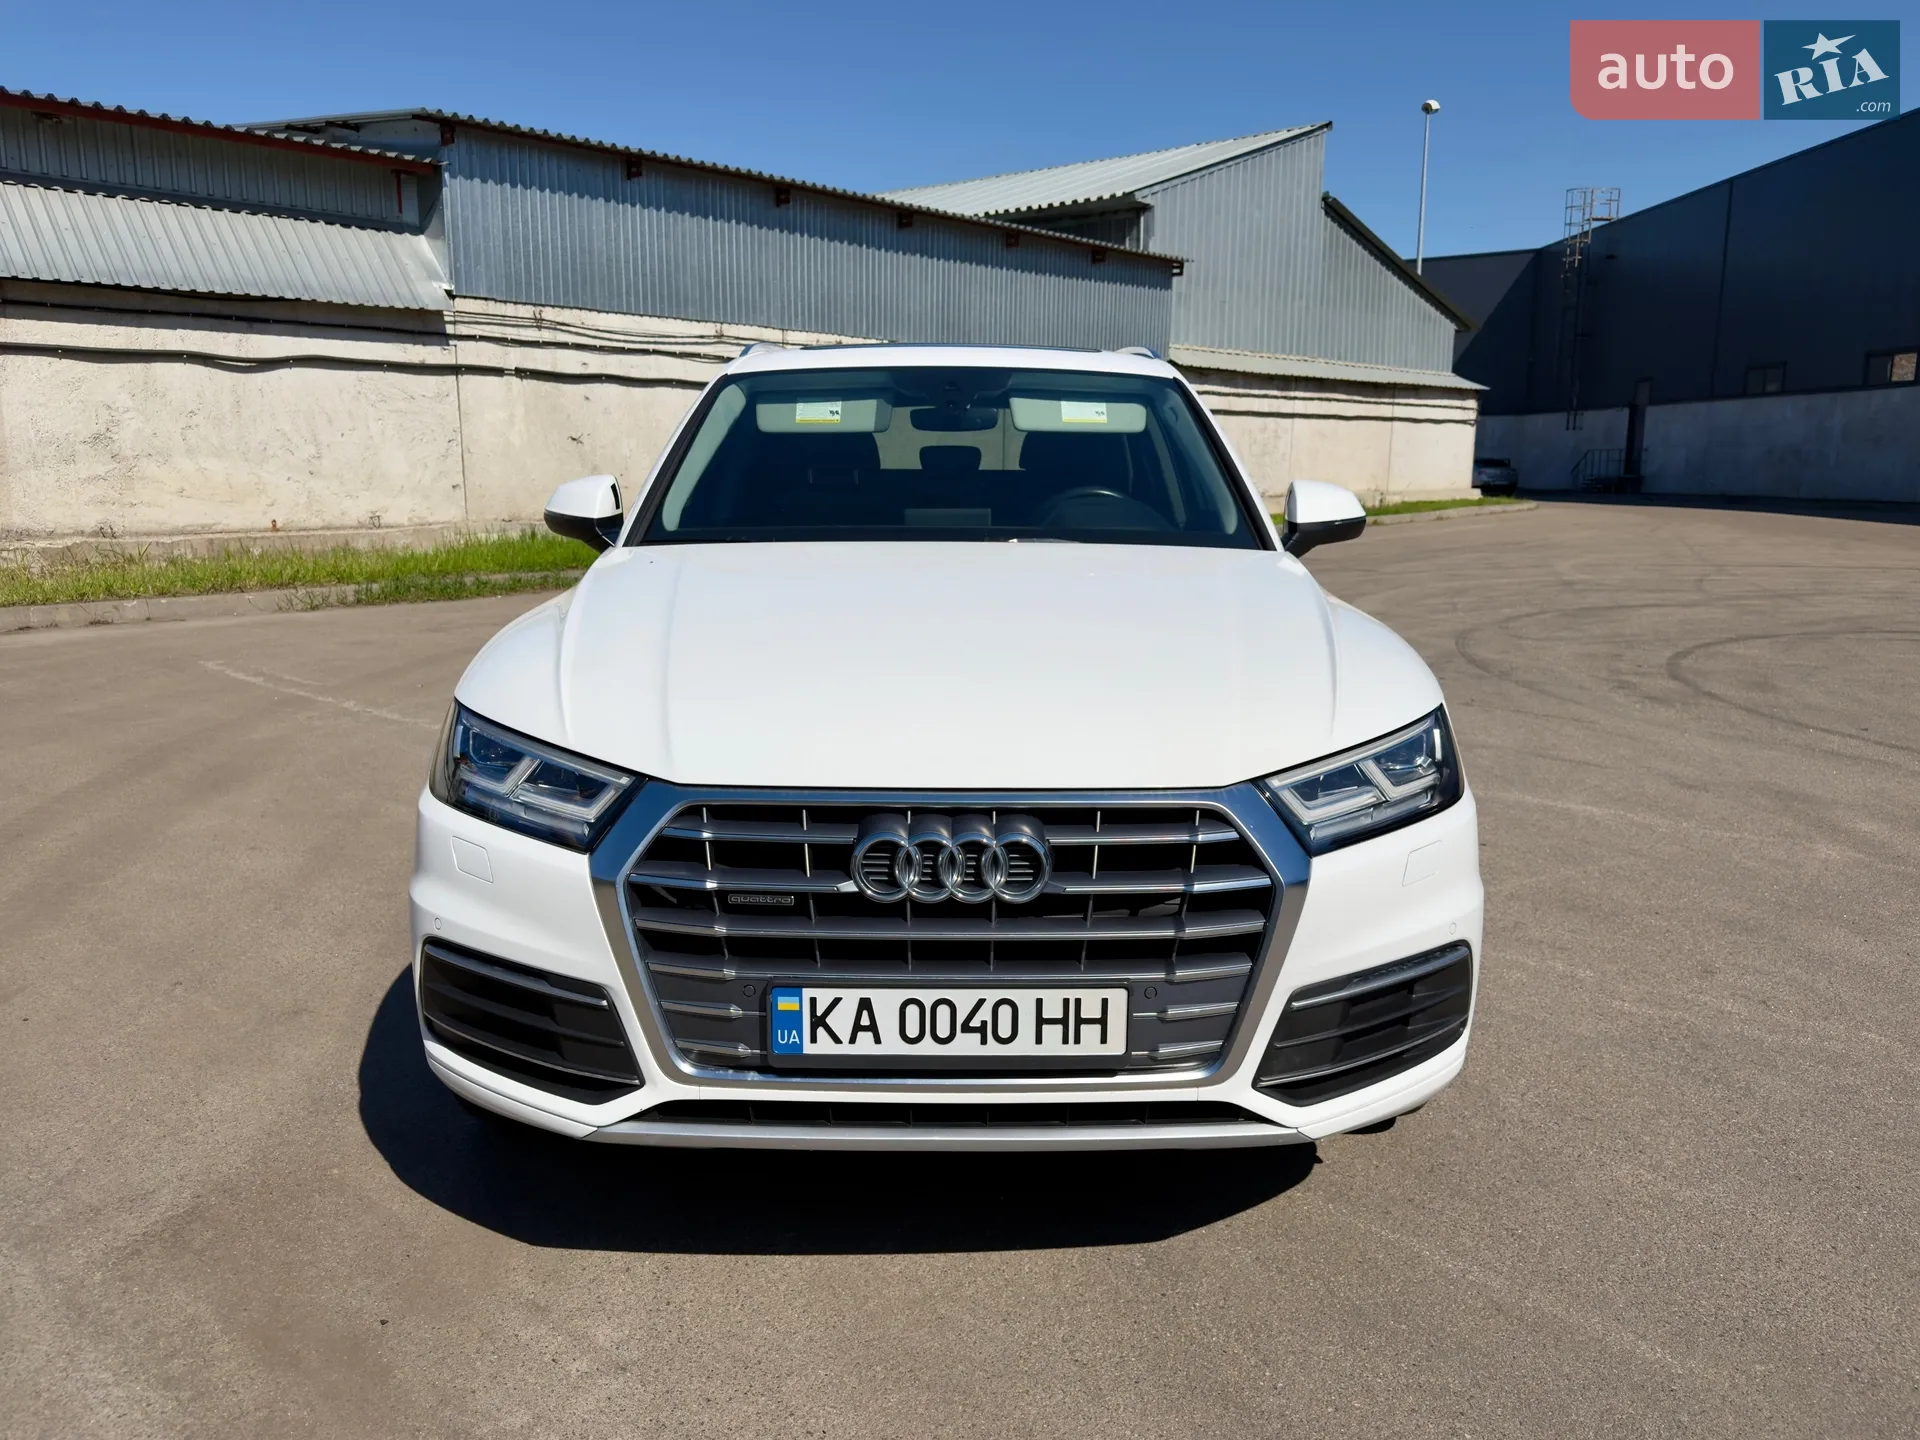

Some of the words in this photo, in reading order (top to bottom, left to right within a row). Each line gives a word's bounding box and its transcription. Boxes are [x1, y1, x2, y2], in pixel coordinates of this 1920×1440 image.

[731, 895, 791, 904] quattro
[808, 996, 883, 1045] KA
[898, 997, 1020, 1046] 0040
[1034, 997, 1109, 1045] HH
[777, 1029, 801, 1045] UA
